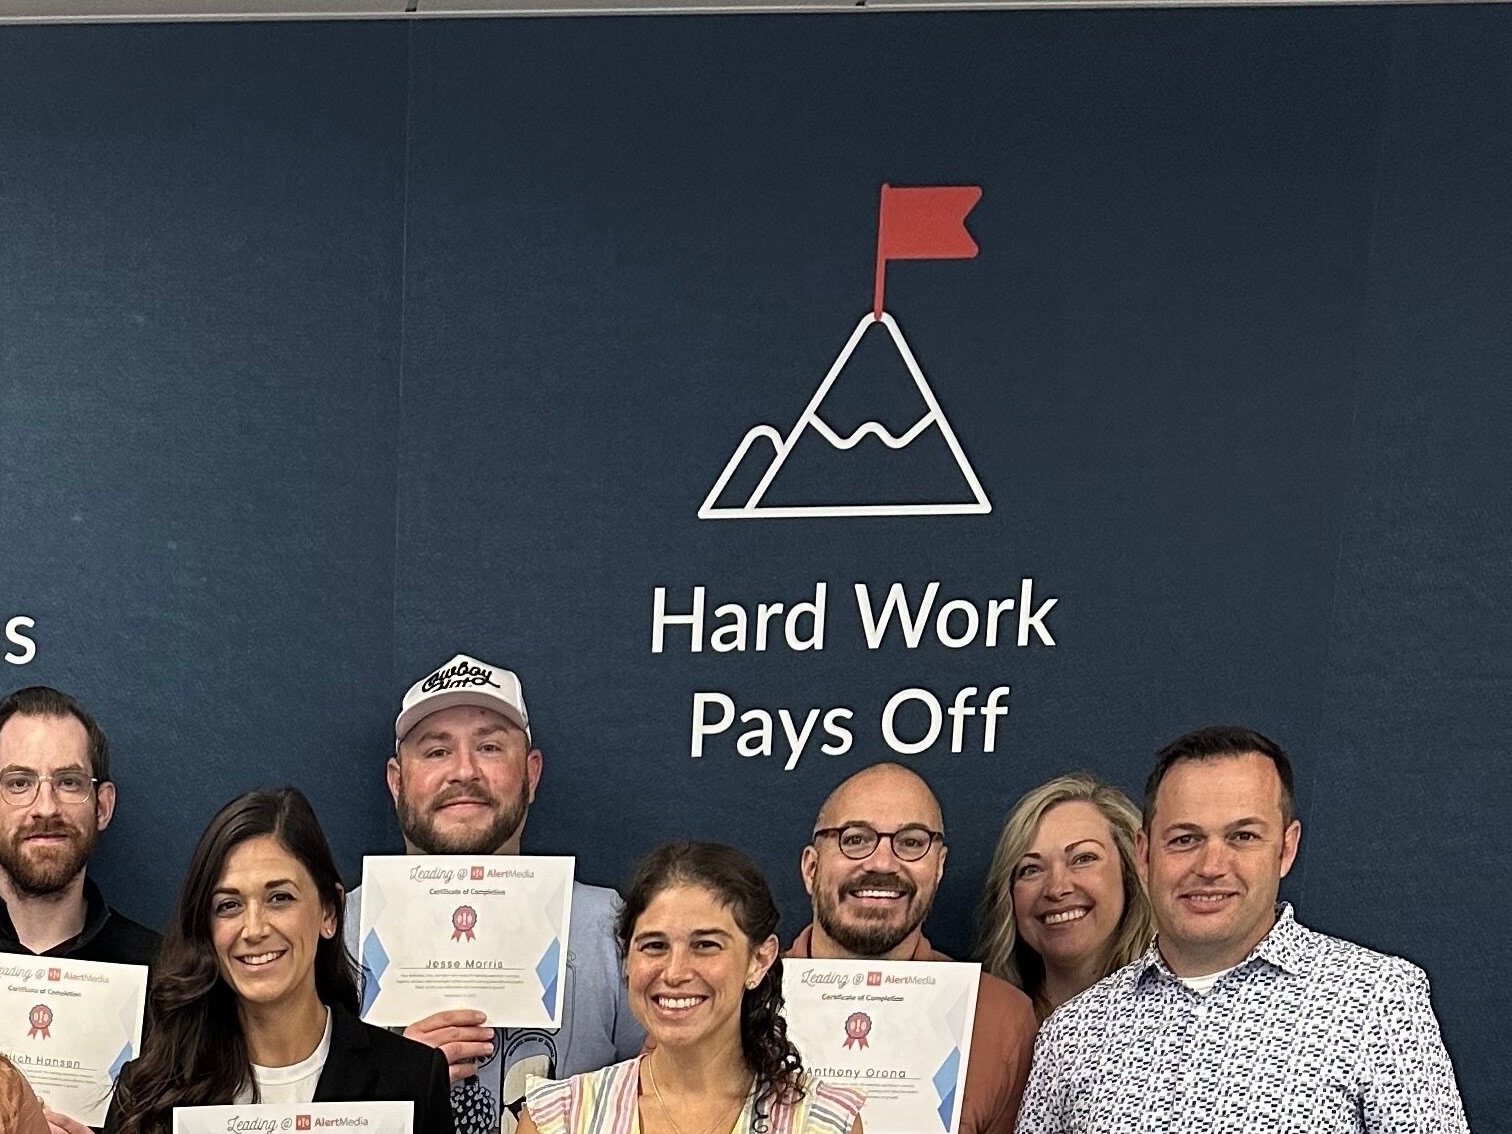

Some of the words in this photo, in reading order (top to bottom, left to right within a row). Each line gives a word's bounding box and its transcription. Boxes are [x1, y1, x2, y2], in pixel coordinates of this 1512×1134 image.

[651, 582, 827, 653] Hard
[854, 578, 1059, 649] Work
[691, 692, 854, 771] Pays
[881, 686, 1010, 754] Off
[410, 865, 456, 883] Leading
[457, 868, 467, 879] @
[487, 869, 534, 879] AlertMedia
[426, 960, 460, 968] Jesse
[466, 960, 503, 969] Morris
[36, 969, 45, 979] @
[801, 969, 850, 989] Leading
[853, 974, 864, 985] @
[37, 1056, 80, 1069] Hansen
[806, 1067, 860, 1078] Anthony
[866, 1069, 906, 1079] Orona
[227, 1115, 277, 1134] Leading
[281, 1118, 292, 1130] @
[315, 1117, 368, 1127] AlertMedia
